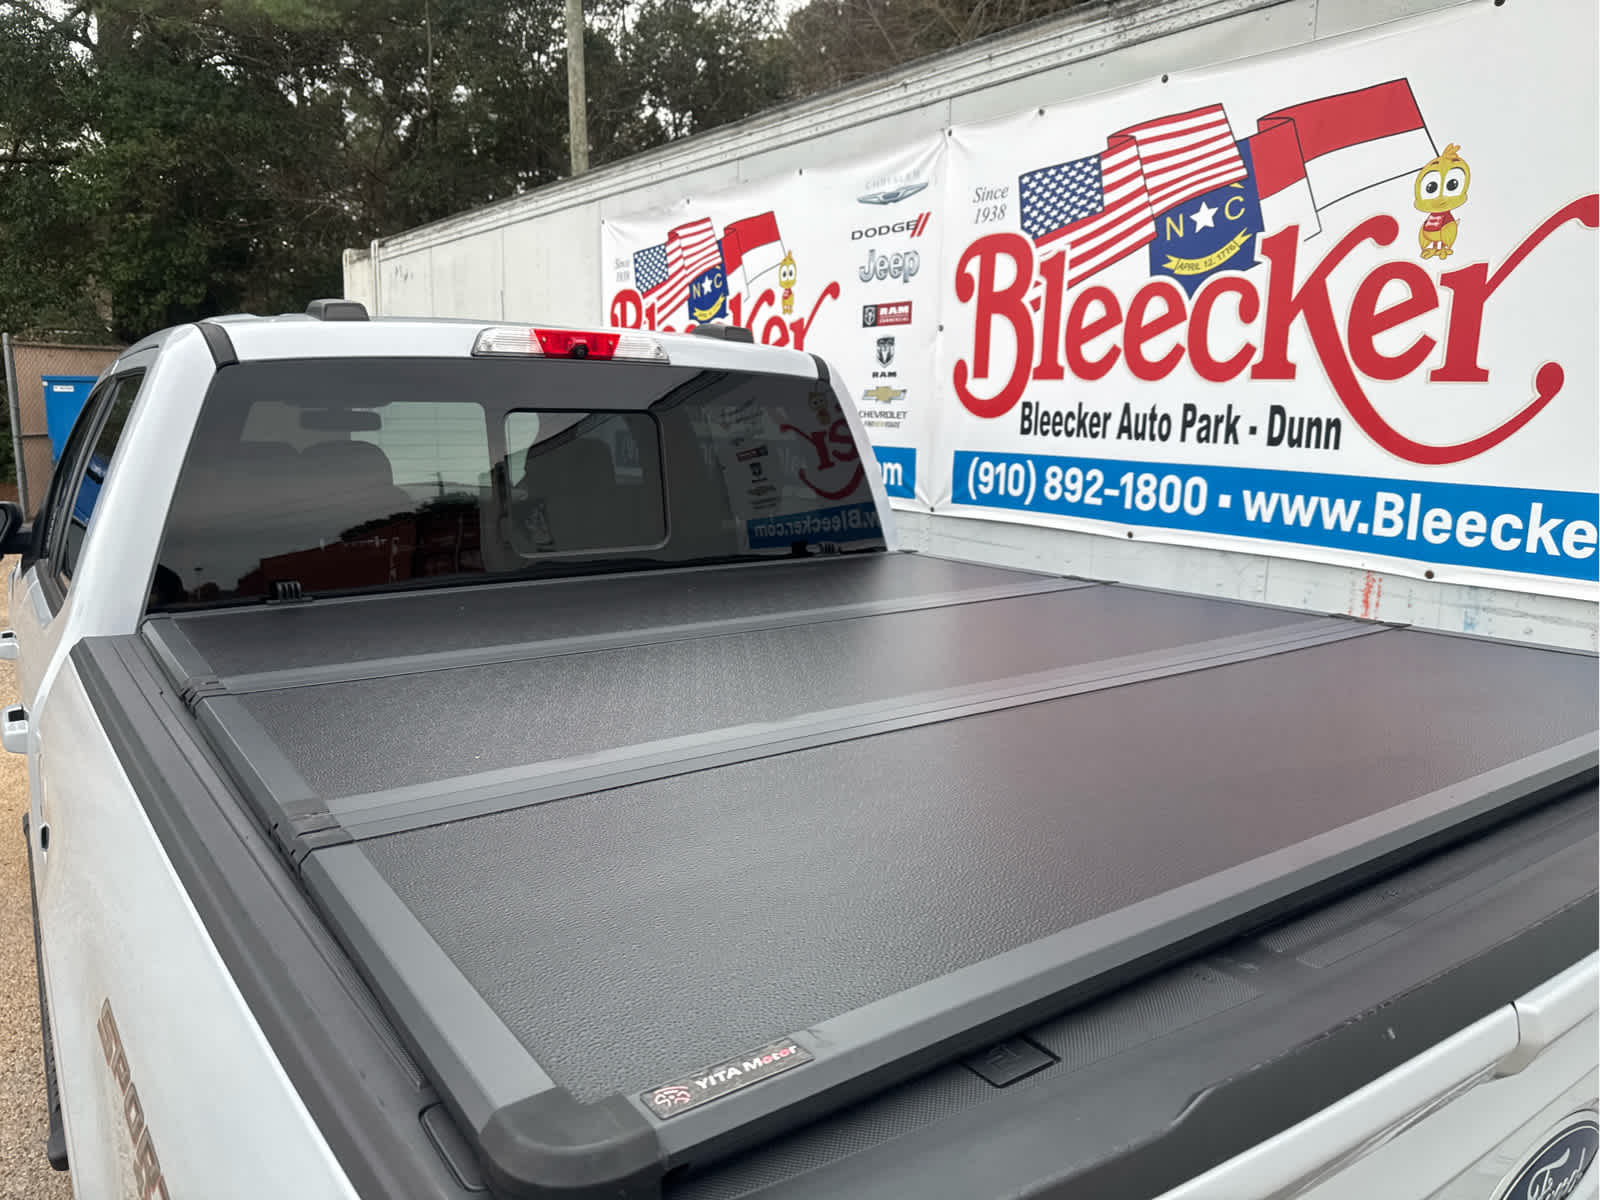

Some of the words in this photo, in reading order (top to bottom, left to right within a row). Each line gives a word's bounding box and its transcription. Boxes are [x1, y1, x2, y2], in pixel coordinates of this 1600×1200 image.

[973, 185, 1009, 204] Since
[974, 203, 1007, 224] 1938
[1165, 213, 1184, 241] N
[1224, 195, 1245, 221] C
[851, 219, 919, 240] DODGE
[859, 248, 920, 284] Jeep
[692, 282, 701, 299] N
[713, 273, 723, 289] C
[880, 305, 909, 315] RAM
[953, 195, 1598, 465] Bleecker
[858, 410, 908, 419] CHEVROLET
[1020, 401, 1112, 439] Bleecker
[1116, 402, 1172, 443] Auto
[1180, 403, 1241, 445] Park
[1266, 405, 1342, 450] Dunn
[968, 457, 1036, 505] (910)
[1043, 465, 1208, 516] 892-1800
[695, 1067, 743, 1090] YITA
[742, 1045, 797, 1072] Motor
